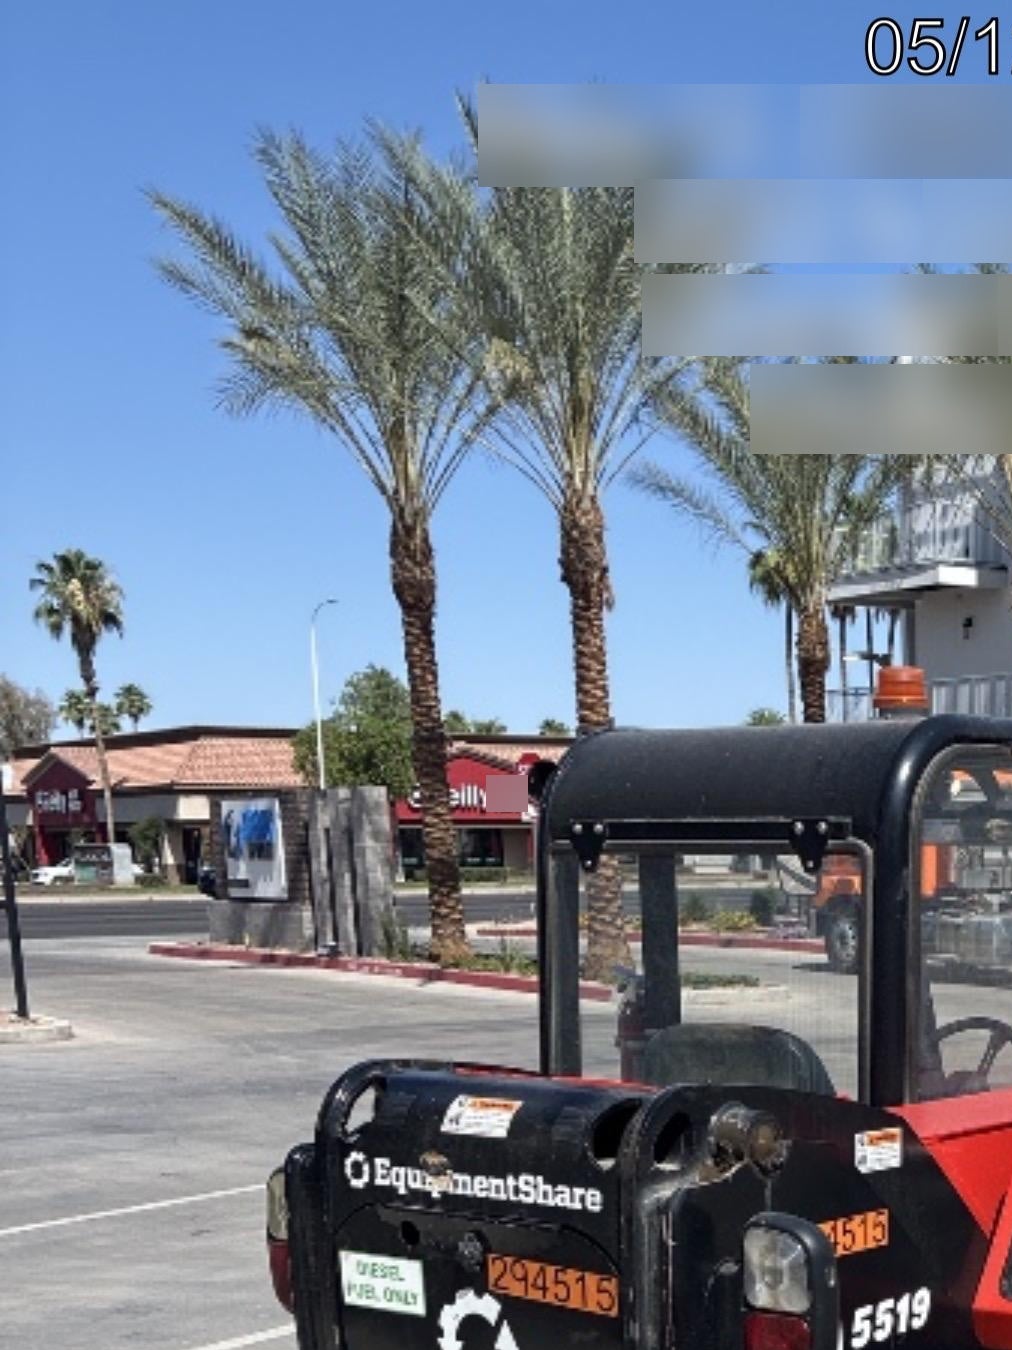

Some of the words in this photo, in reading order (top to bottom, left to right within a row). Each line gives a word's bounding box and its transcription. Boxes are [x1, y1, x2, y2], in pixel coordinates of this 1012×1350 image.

[356, 1260, 406, 1283] DIESEL
[491, 1256, 616, 1313] 294515
[347, 1280, 382, 1302] FUEL
[383, 1286, 418, 1306] ONLY
[851, 1286, 932, 1349] 5519
